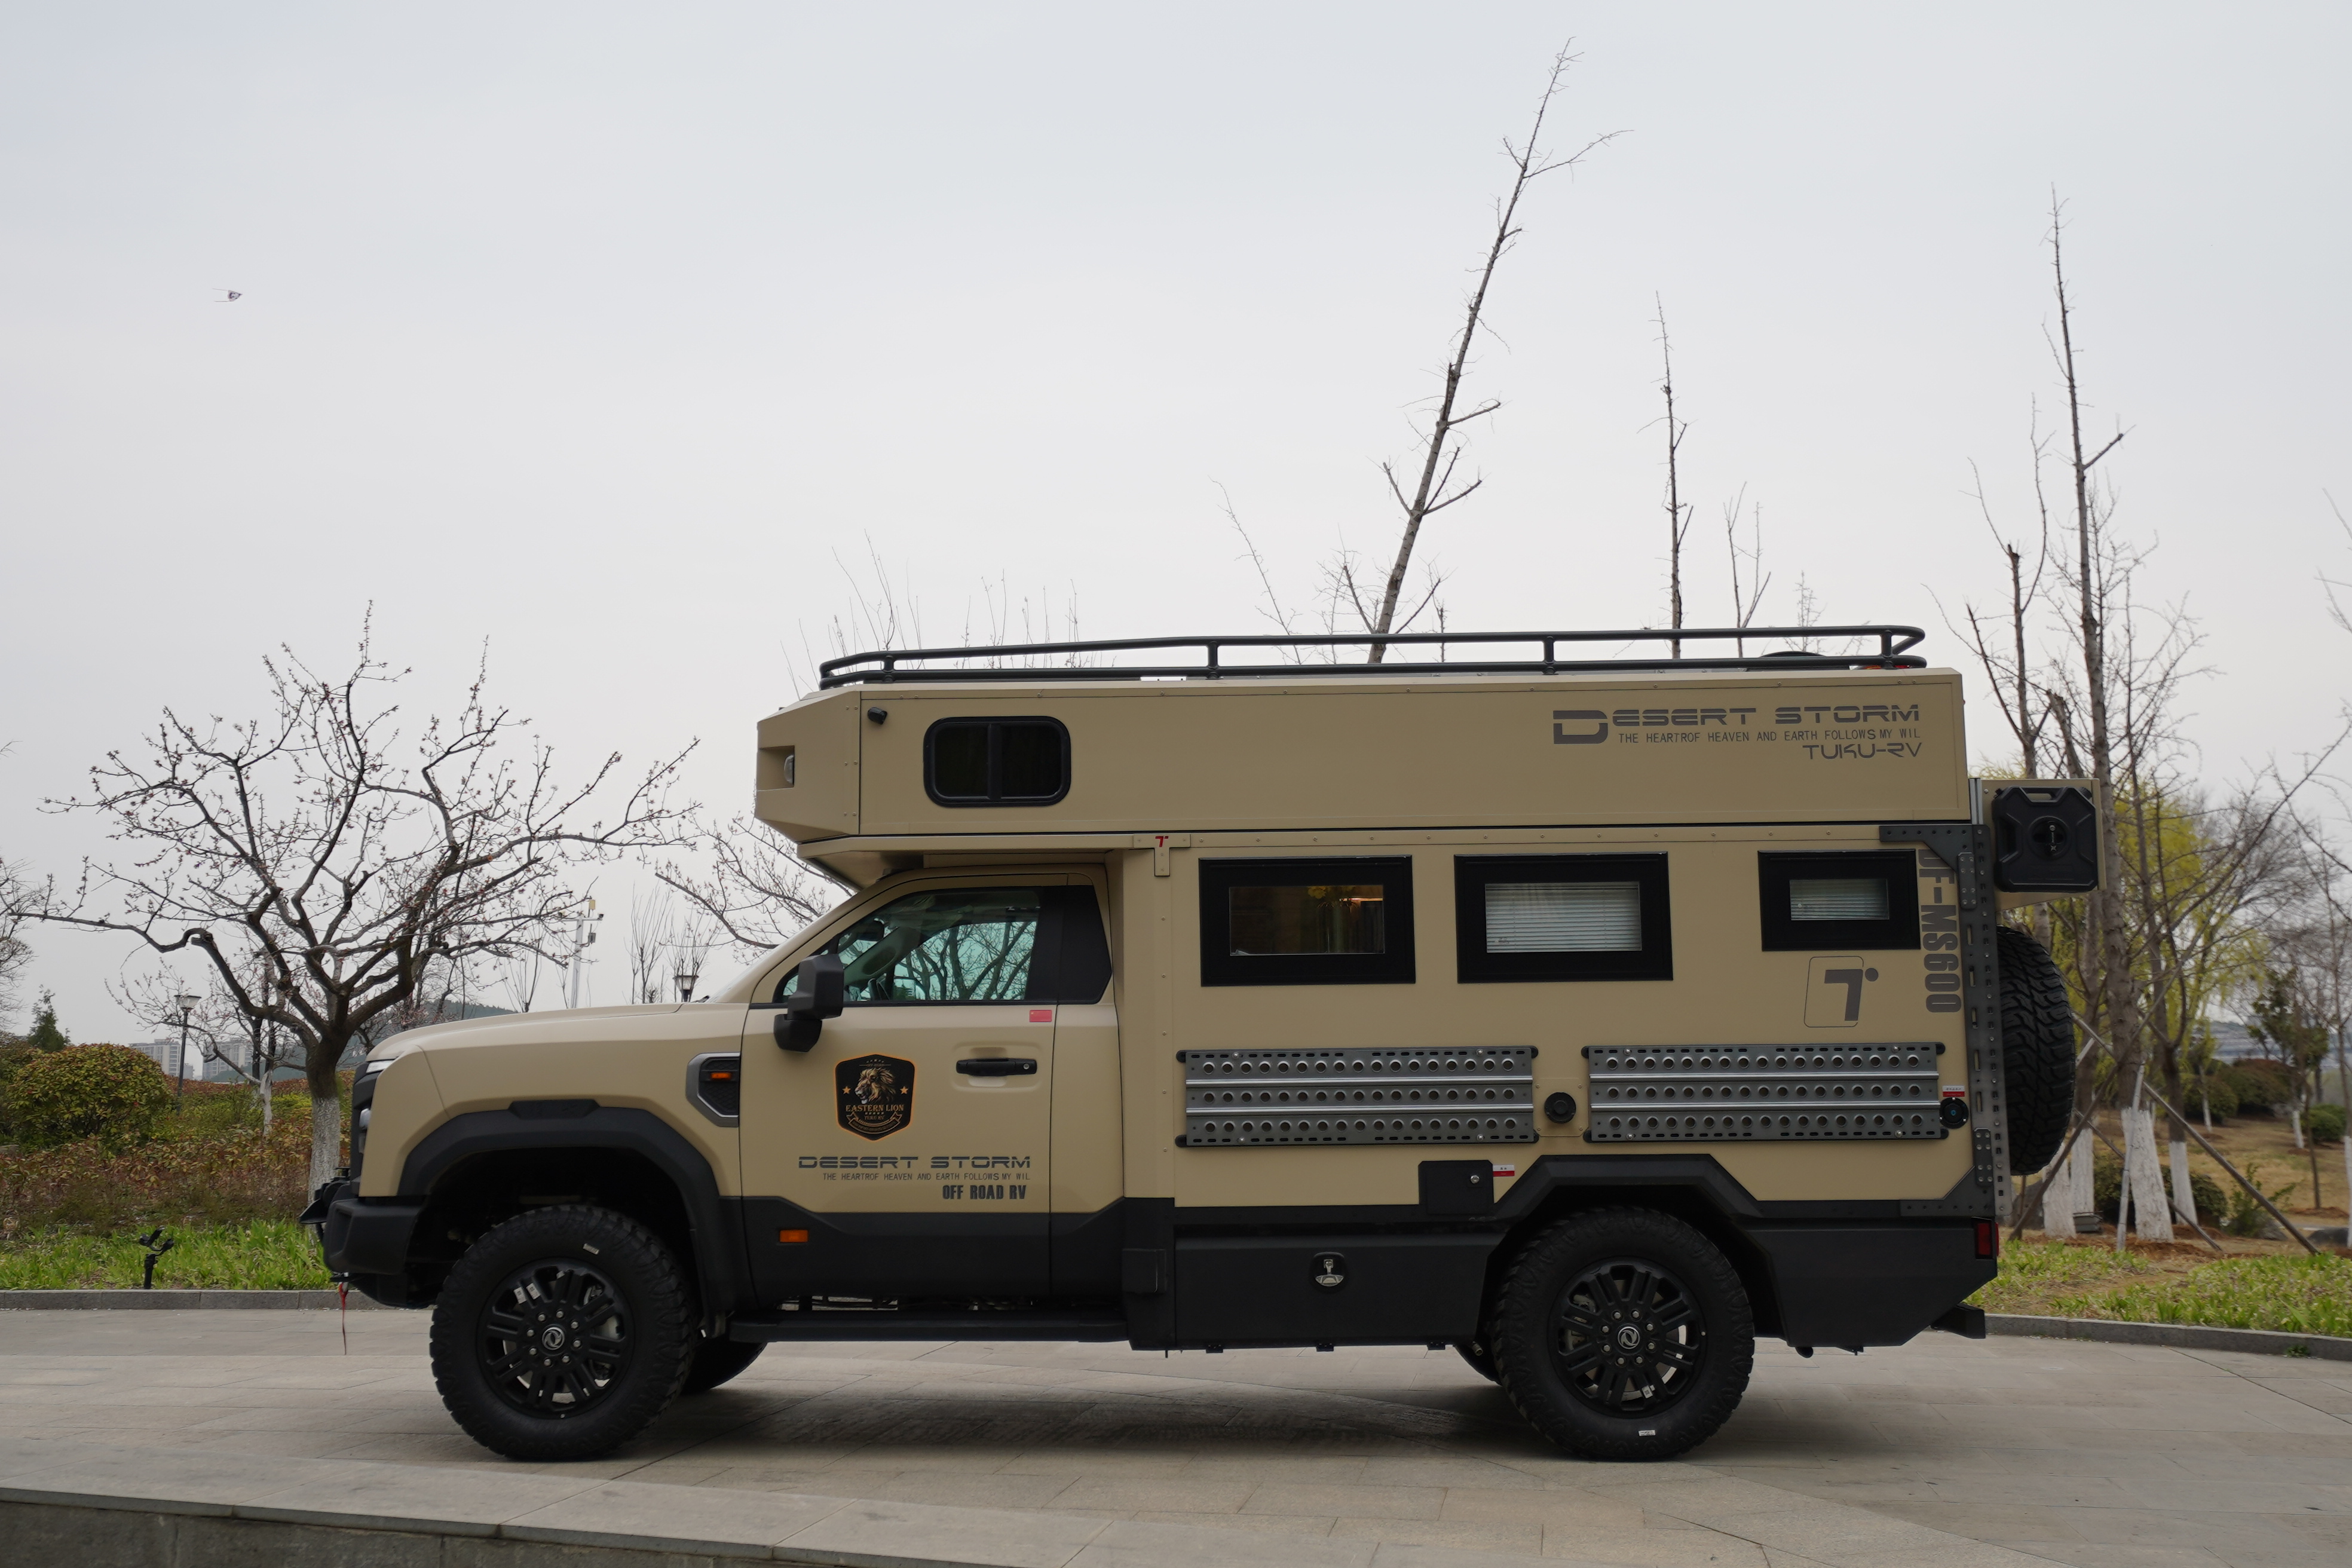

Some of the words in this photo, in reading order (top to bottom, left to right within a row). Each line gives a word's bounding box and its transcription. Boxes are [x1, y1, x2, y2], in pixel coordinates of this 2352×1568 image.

[1552, 708, 1757, 745] DESERT
[1775, 705, 1919, 724] STORM
[1618, 733, 1639, 743] THE
[1646, 732, 1701, 743] HEARTROF
[1708, 731, 1749, 742] HEAVEN
[1756, 731, 1777, 742] AND
[1784, 730, 1818, 741] EARTH
[1824, 728, 1876, 740] FOLLOWS
[1879, 728, 1892, 739] MY
[1899, 728, 1921, 739] WIL
[798, 1156, 918, 1169] DESERT
[930, 1156, 1030, 1169] STORM
[942, 1184, 964, 1200] OFF
[969, 1184, 1004, 1200] ROAD
[1009, 1184, 1027, 1200] RV
